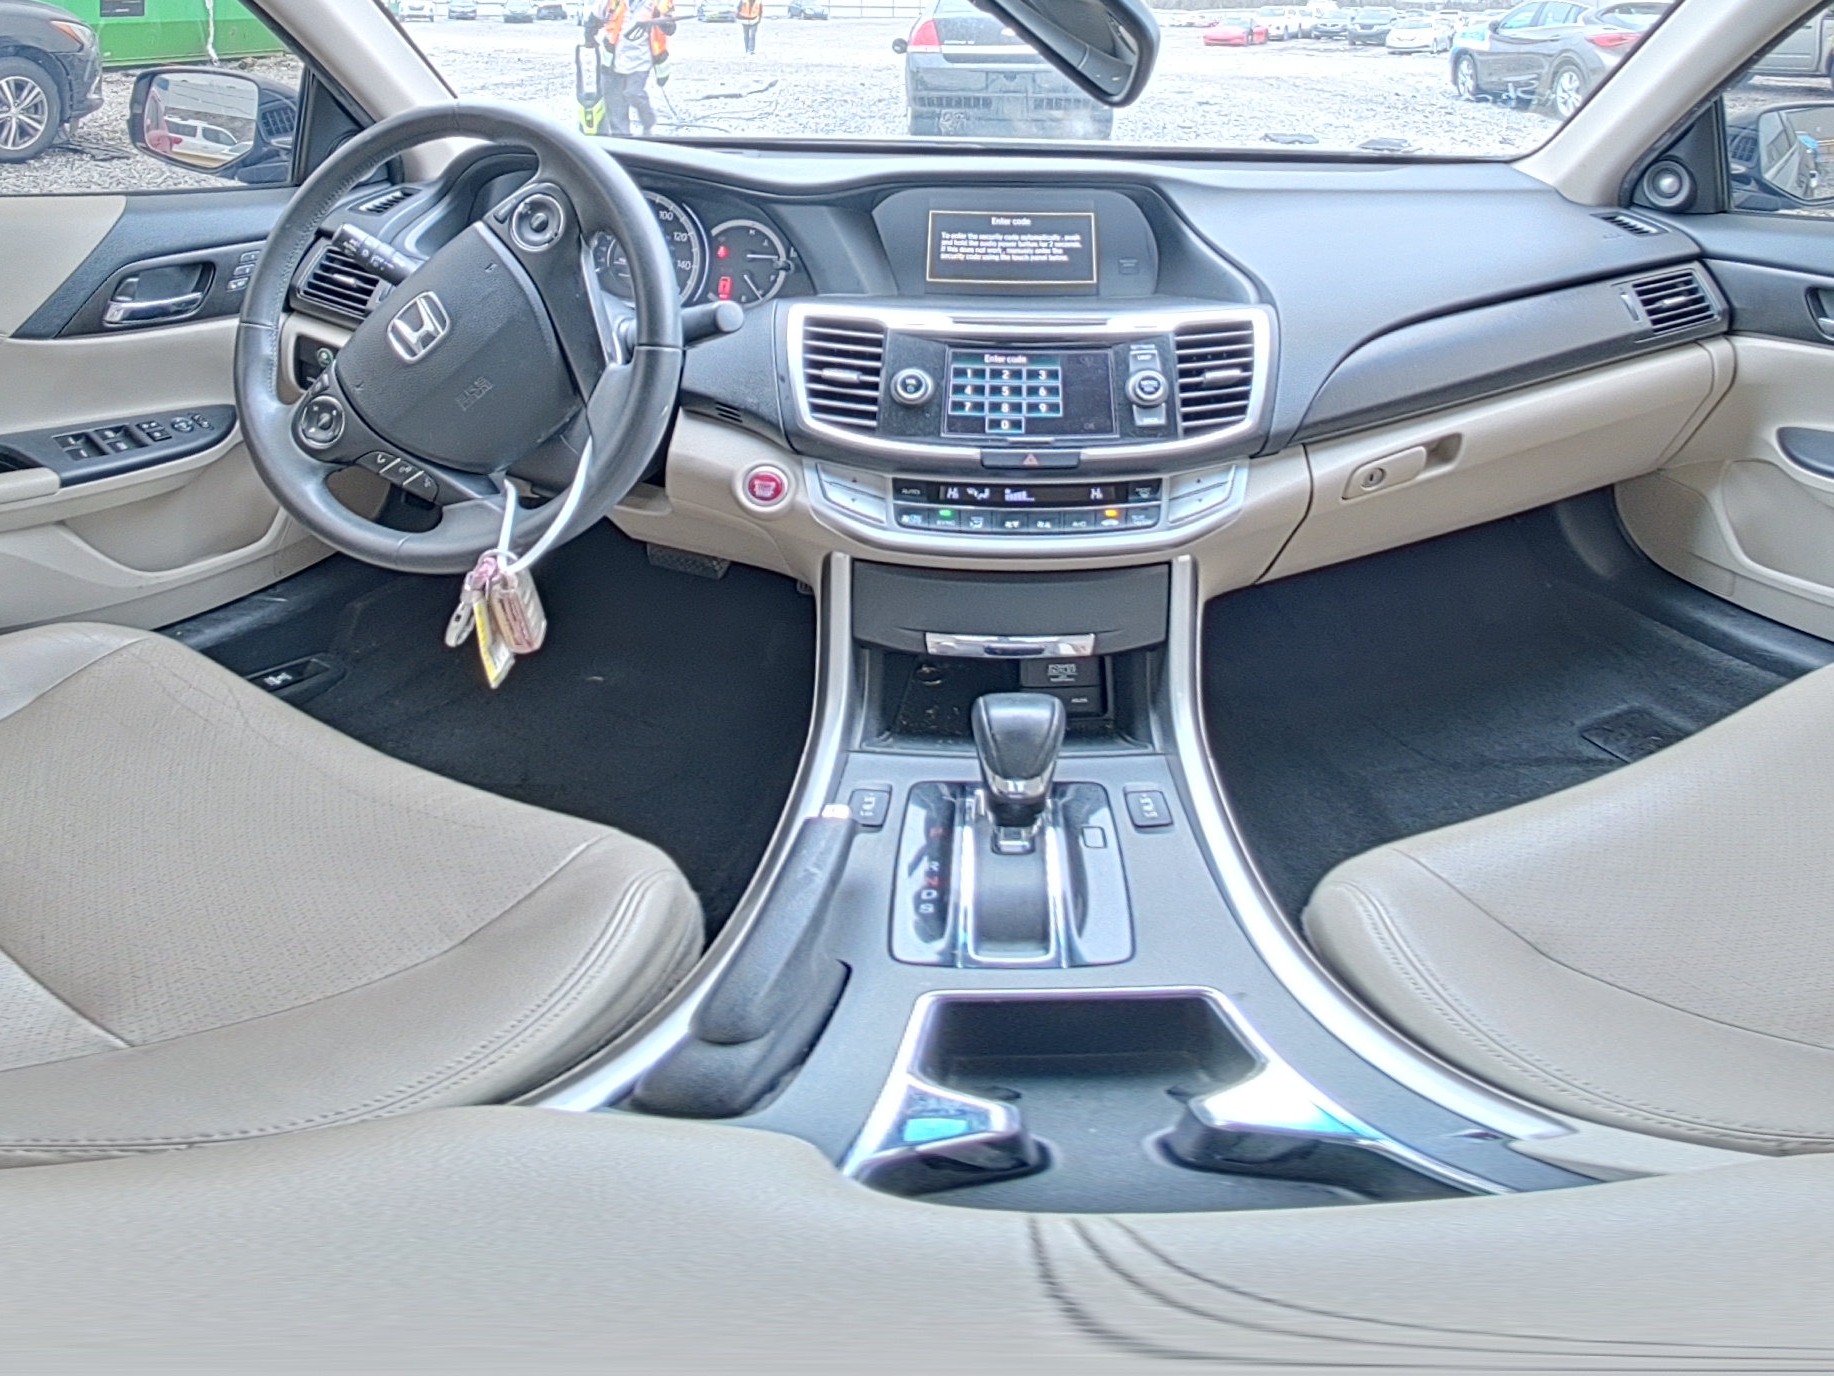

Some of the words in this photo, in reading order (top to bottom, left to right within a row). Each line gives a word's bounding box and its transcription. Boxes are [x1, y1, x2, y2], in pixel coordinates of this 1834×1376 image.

[659, 211, 673, 221] 100
[991, 217, 1011, 225] Enter
[1012, 217, 1031, 225] code
[673, 232, 687, 242] 120
[676, 259, 691, 270] 140
[984, 354, 1006, 363] Enter
[1006, 354, 1028, 364] code
[967, 369, 972, 378] 1
[1002, 370, 1010, 379] 2
[1038, 370, 1047, 380] 3
[964, 385, 972, 395] 4
[1001, 386, 1009, 396] 5
[1039, 387, 1047, 396] 6
[965, 402, 972, 411] 7
[1001, 403, 1009, 413] 8
[1039, 403, 1047, 412] 9
[1001, 420, 1009, 429] 0
[901, 488, 921, 496] AUTO
[920, 889, 938, 900] D
